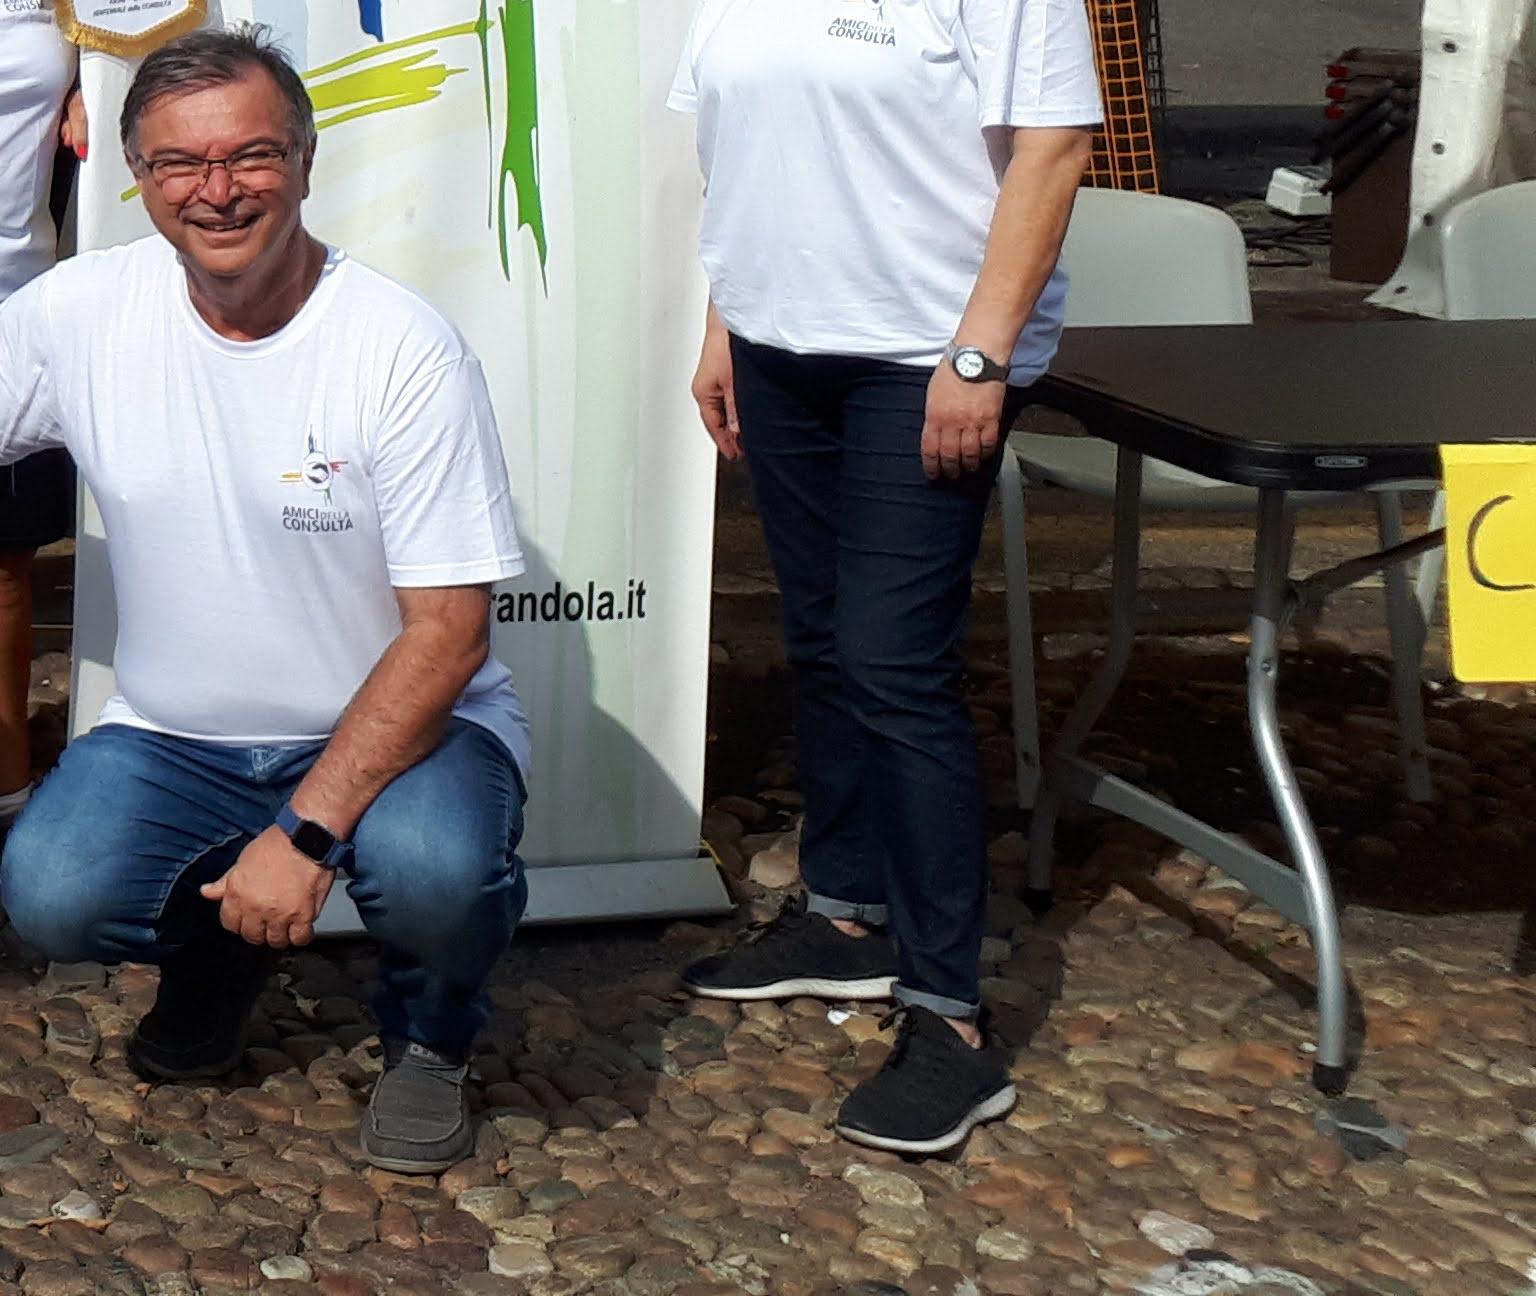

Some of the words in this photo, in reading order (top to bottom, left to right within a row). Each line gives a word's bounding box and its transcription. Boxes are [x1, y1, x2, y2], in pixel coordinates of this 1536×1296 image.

[832, 17, 868, 31] AMICI
[827, 25, 897, 47] CONSULTA
[282, 505, 320, 520] AMICI
[320, 510, 350, 521] DELLA
[282, 517, 354, 533] CONSULTA
